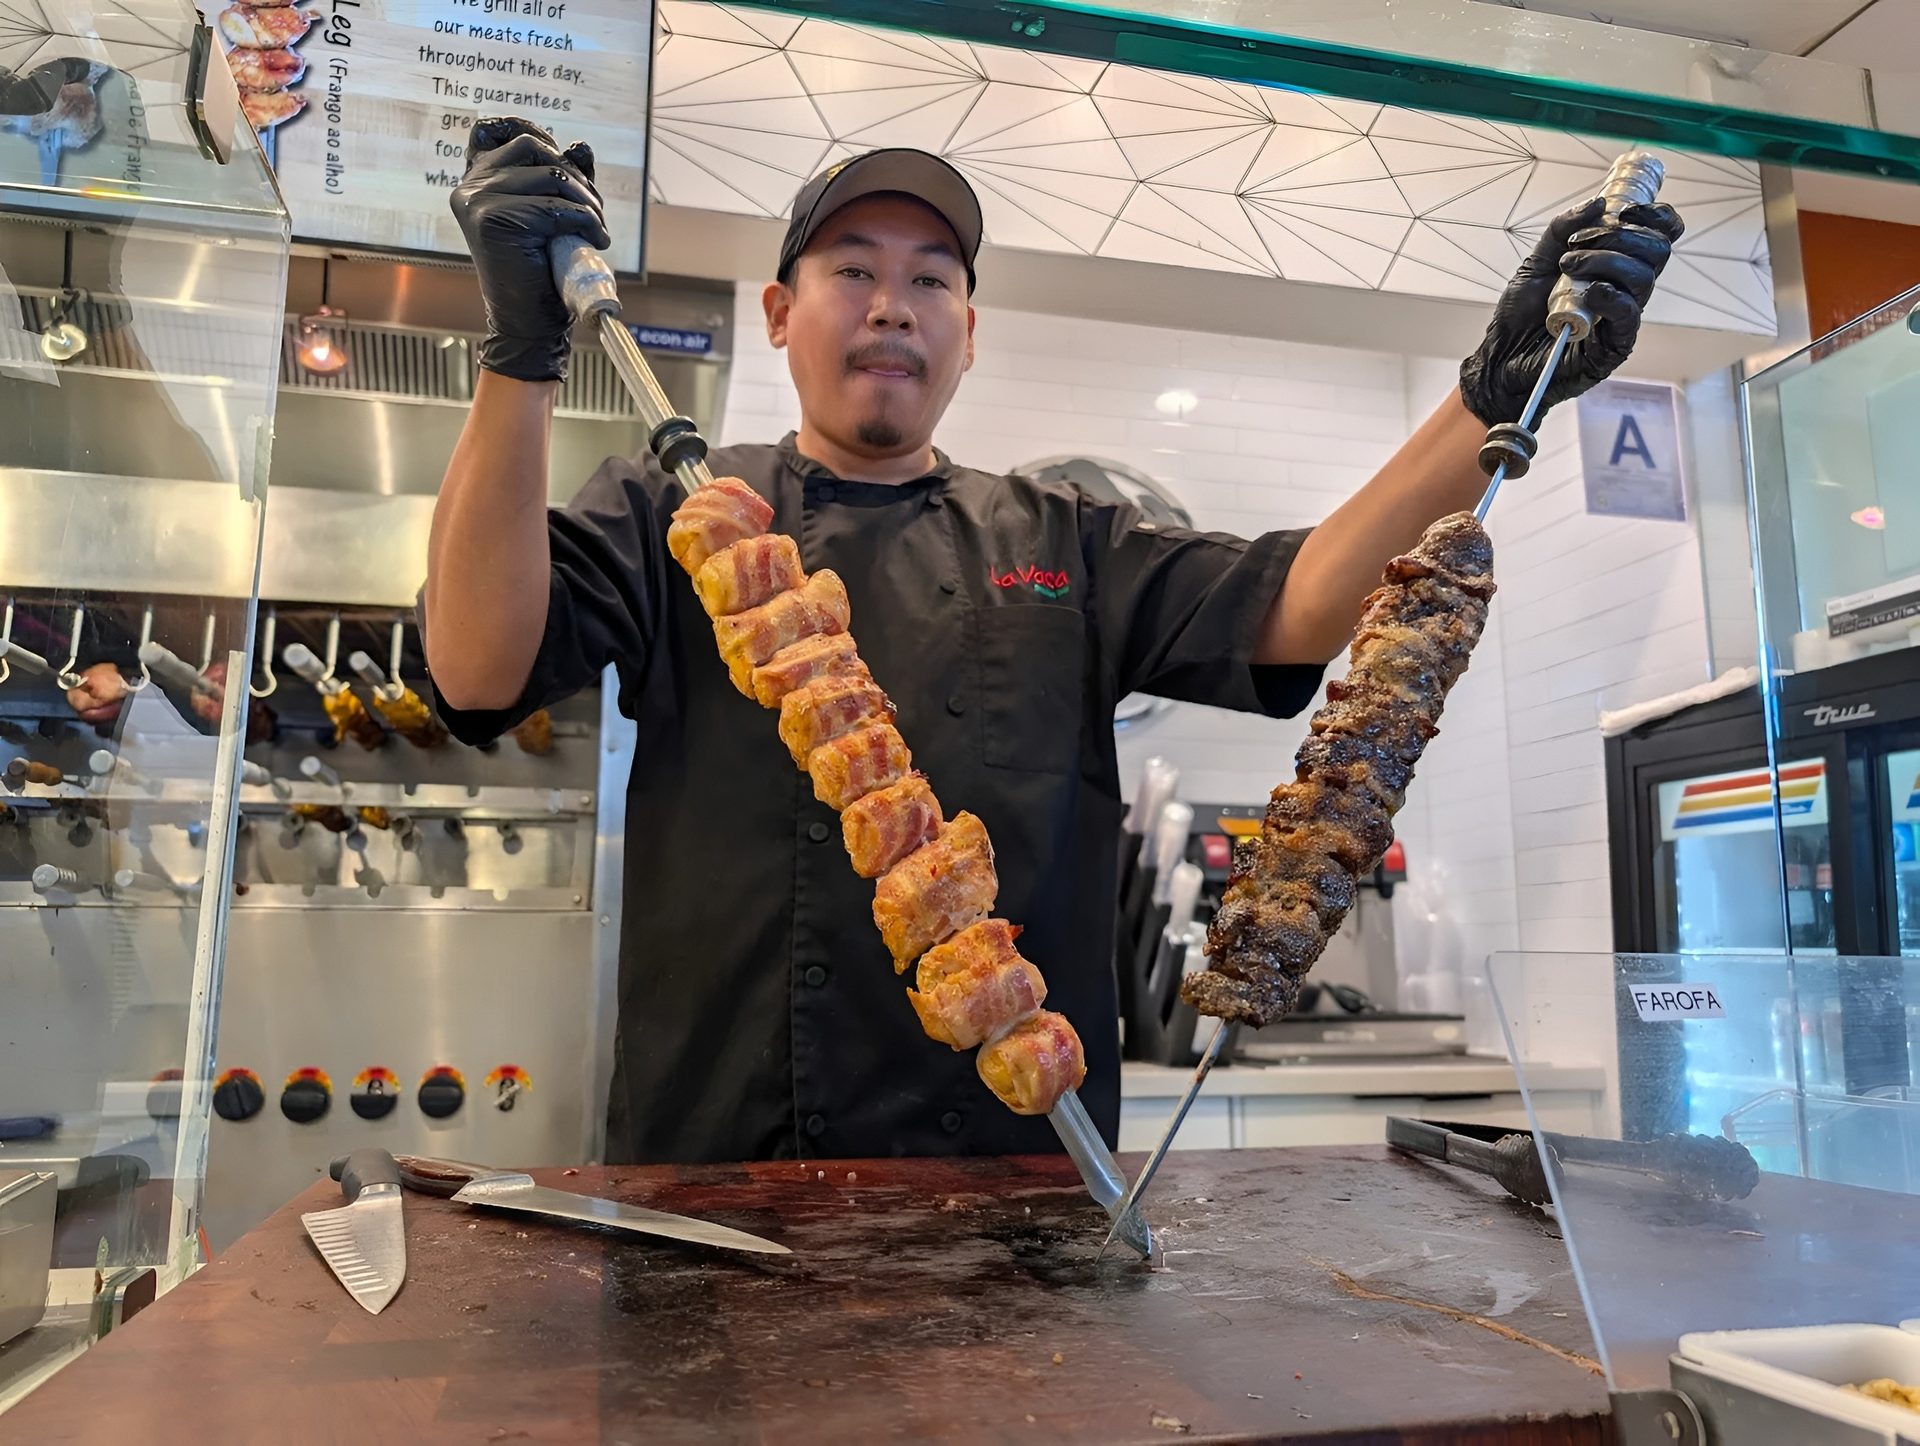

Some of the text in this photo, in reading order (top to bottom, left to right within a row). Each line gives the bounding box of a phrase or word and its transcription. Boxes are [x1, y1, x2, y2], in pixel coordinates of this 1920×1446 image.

[324, 0, 361, 48] Leg
[483, 0, 517, 13] grill
[522, 0, 542, 17] all
[547, 3, 566, 20] of
[434, 19, 574, 51] our meats fresh
[418, 45, 586, 86] throughout the day.
[431, 77, 572, 112] This guarantees
[324, 57, 349, 196] (Frango ao alho)
[440, 111, 471, 131] gre
[435, 140, 463, 158] foo
[425, 169, 463, 188] wha
[1609, 413, 1657, 469] A
[989, 564, 1018, 588] La
[1634, 990, 1722, 1012] FAROFA
